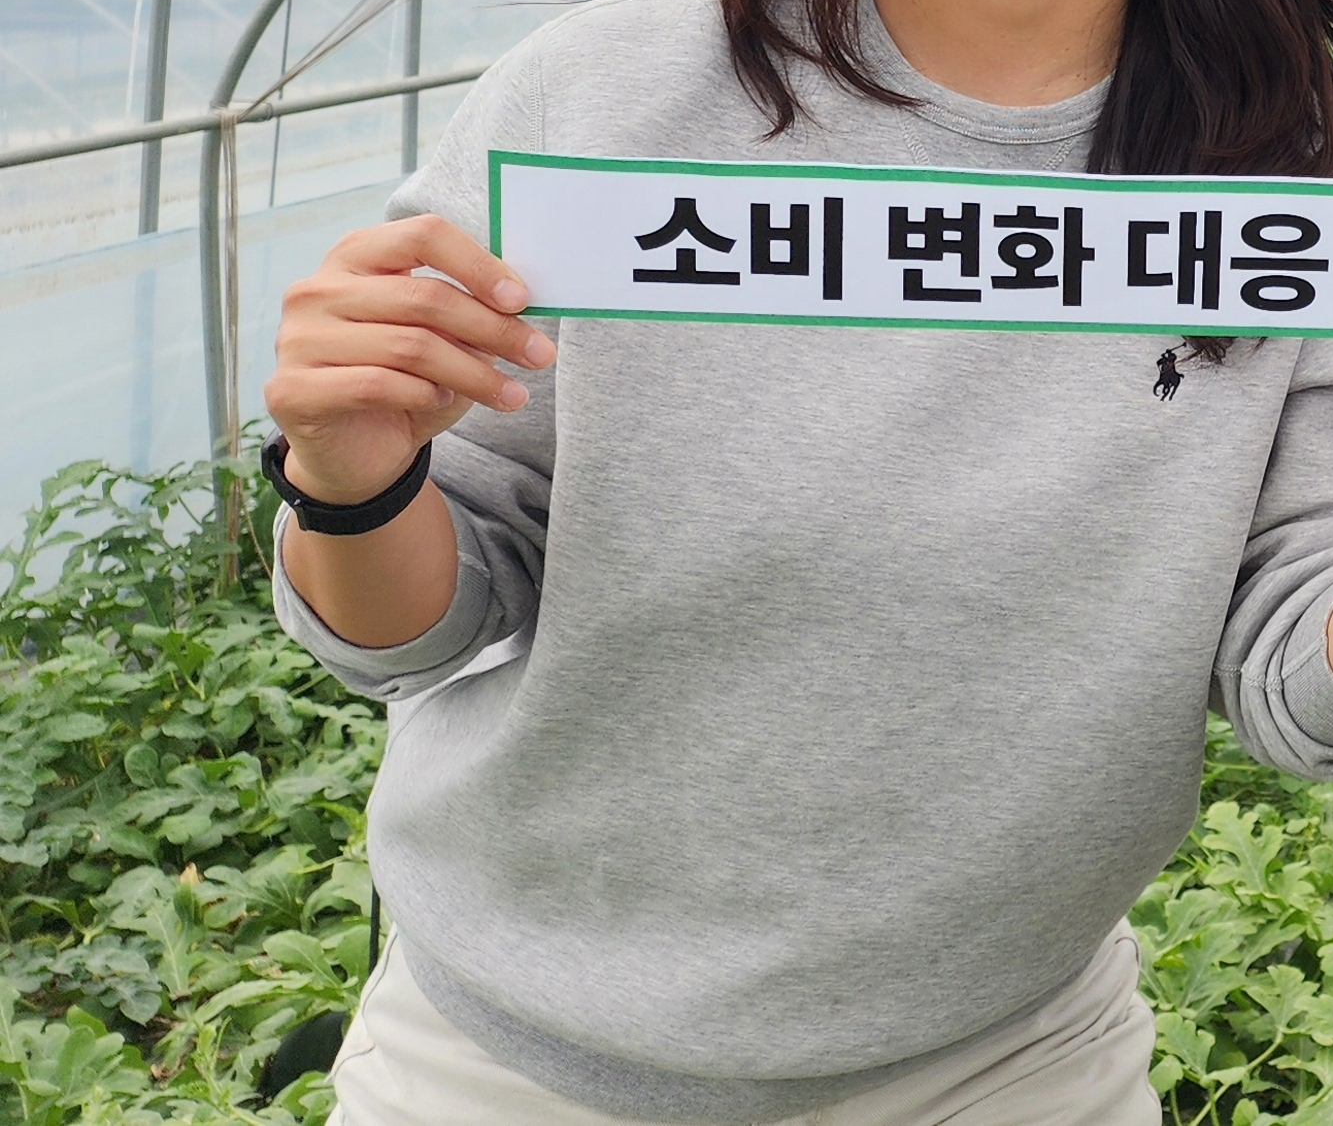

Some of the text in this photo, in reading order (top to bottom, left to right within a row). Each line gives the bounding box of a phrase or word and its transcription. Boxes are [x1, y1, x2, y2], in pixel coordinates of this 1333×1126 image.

[632, 197, 1330, 312] 소비 변화 대응
